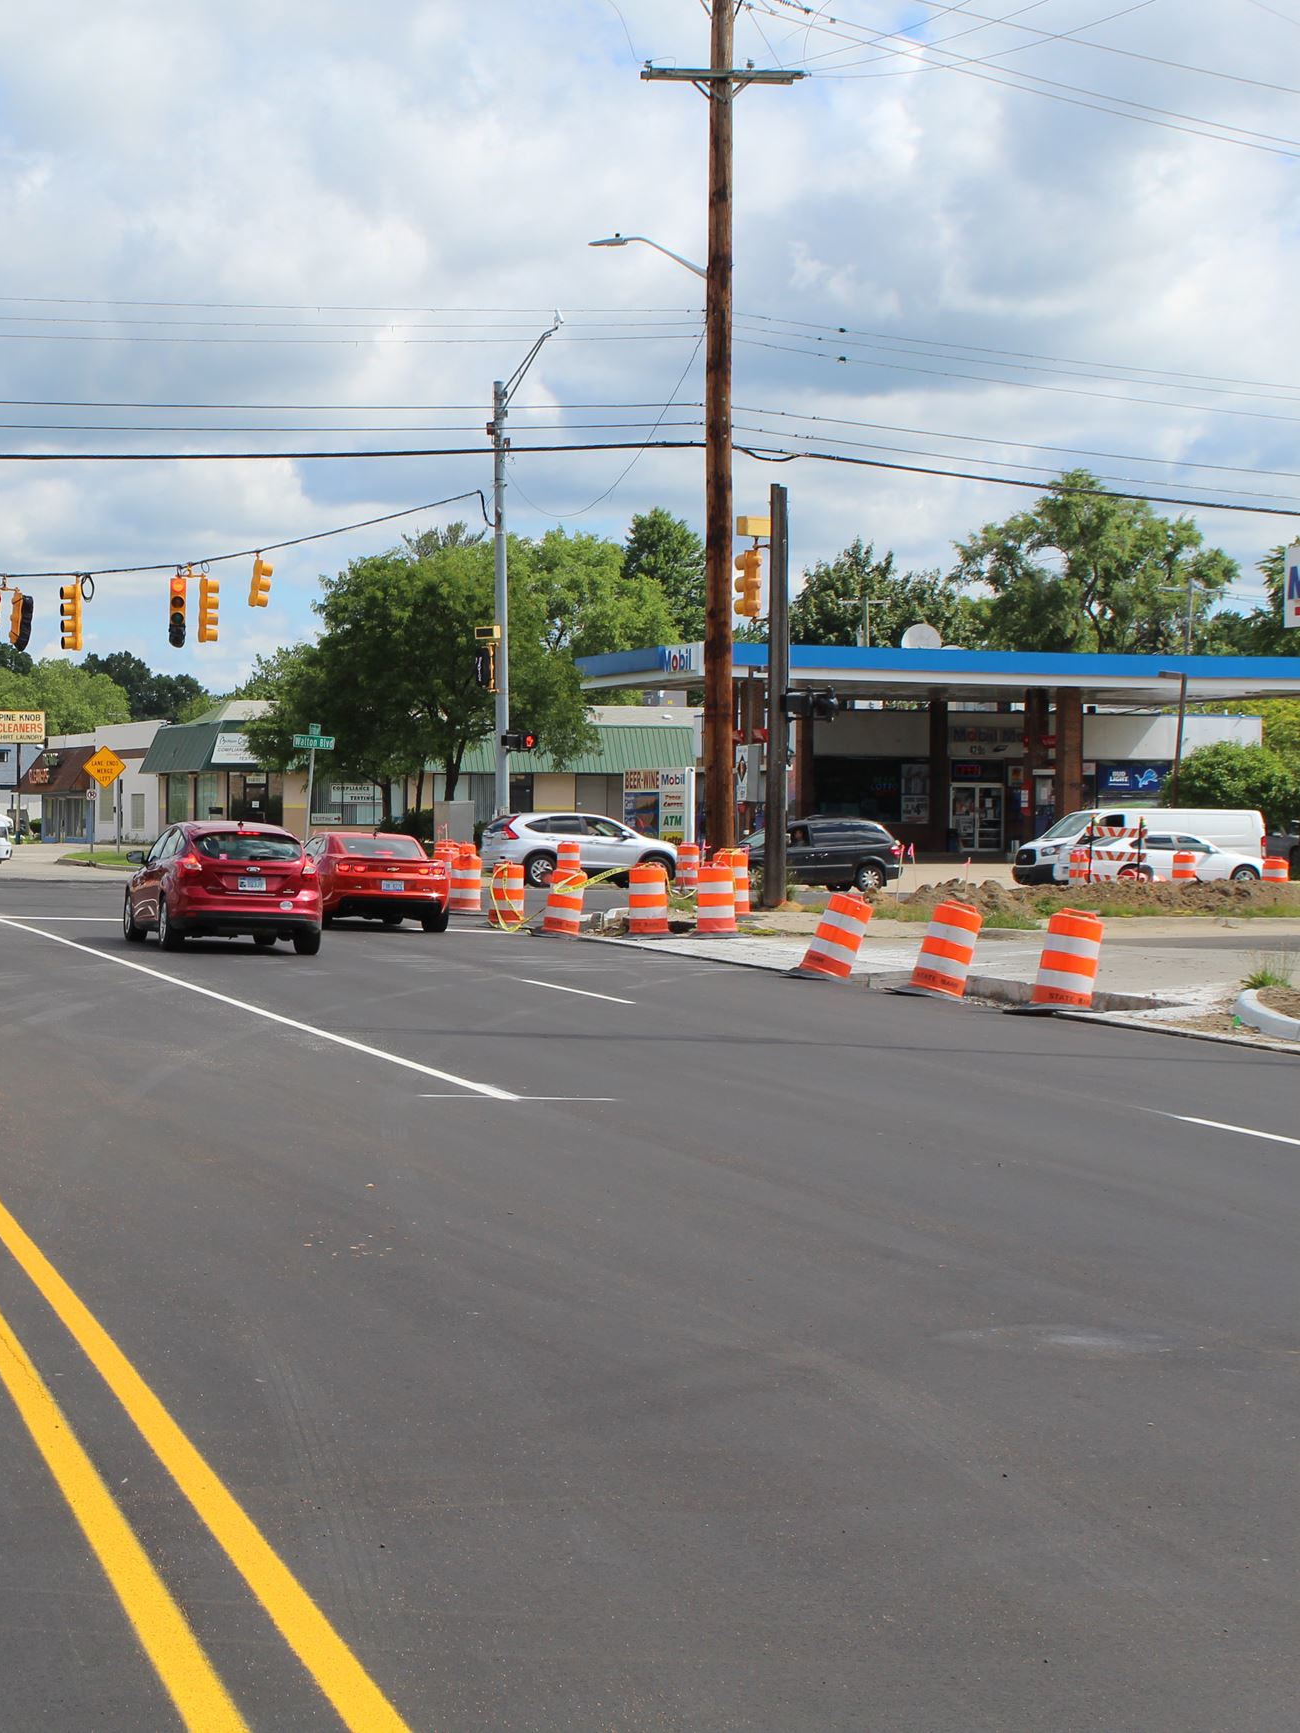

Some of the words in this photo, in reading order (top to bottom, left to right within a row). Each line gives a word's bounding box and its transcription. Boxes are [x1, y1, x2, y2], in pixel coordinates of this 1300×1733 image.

[663, 648, 692, 672] Mobil
[295, 736, 317, 746] Walton
[320, 738, 333, 748] Blvd
[625, 771, 659, 789] BEER-WINE
[661, 774, 685, 785] Mobil
[663, 815, 682, 827] ATM
